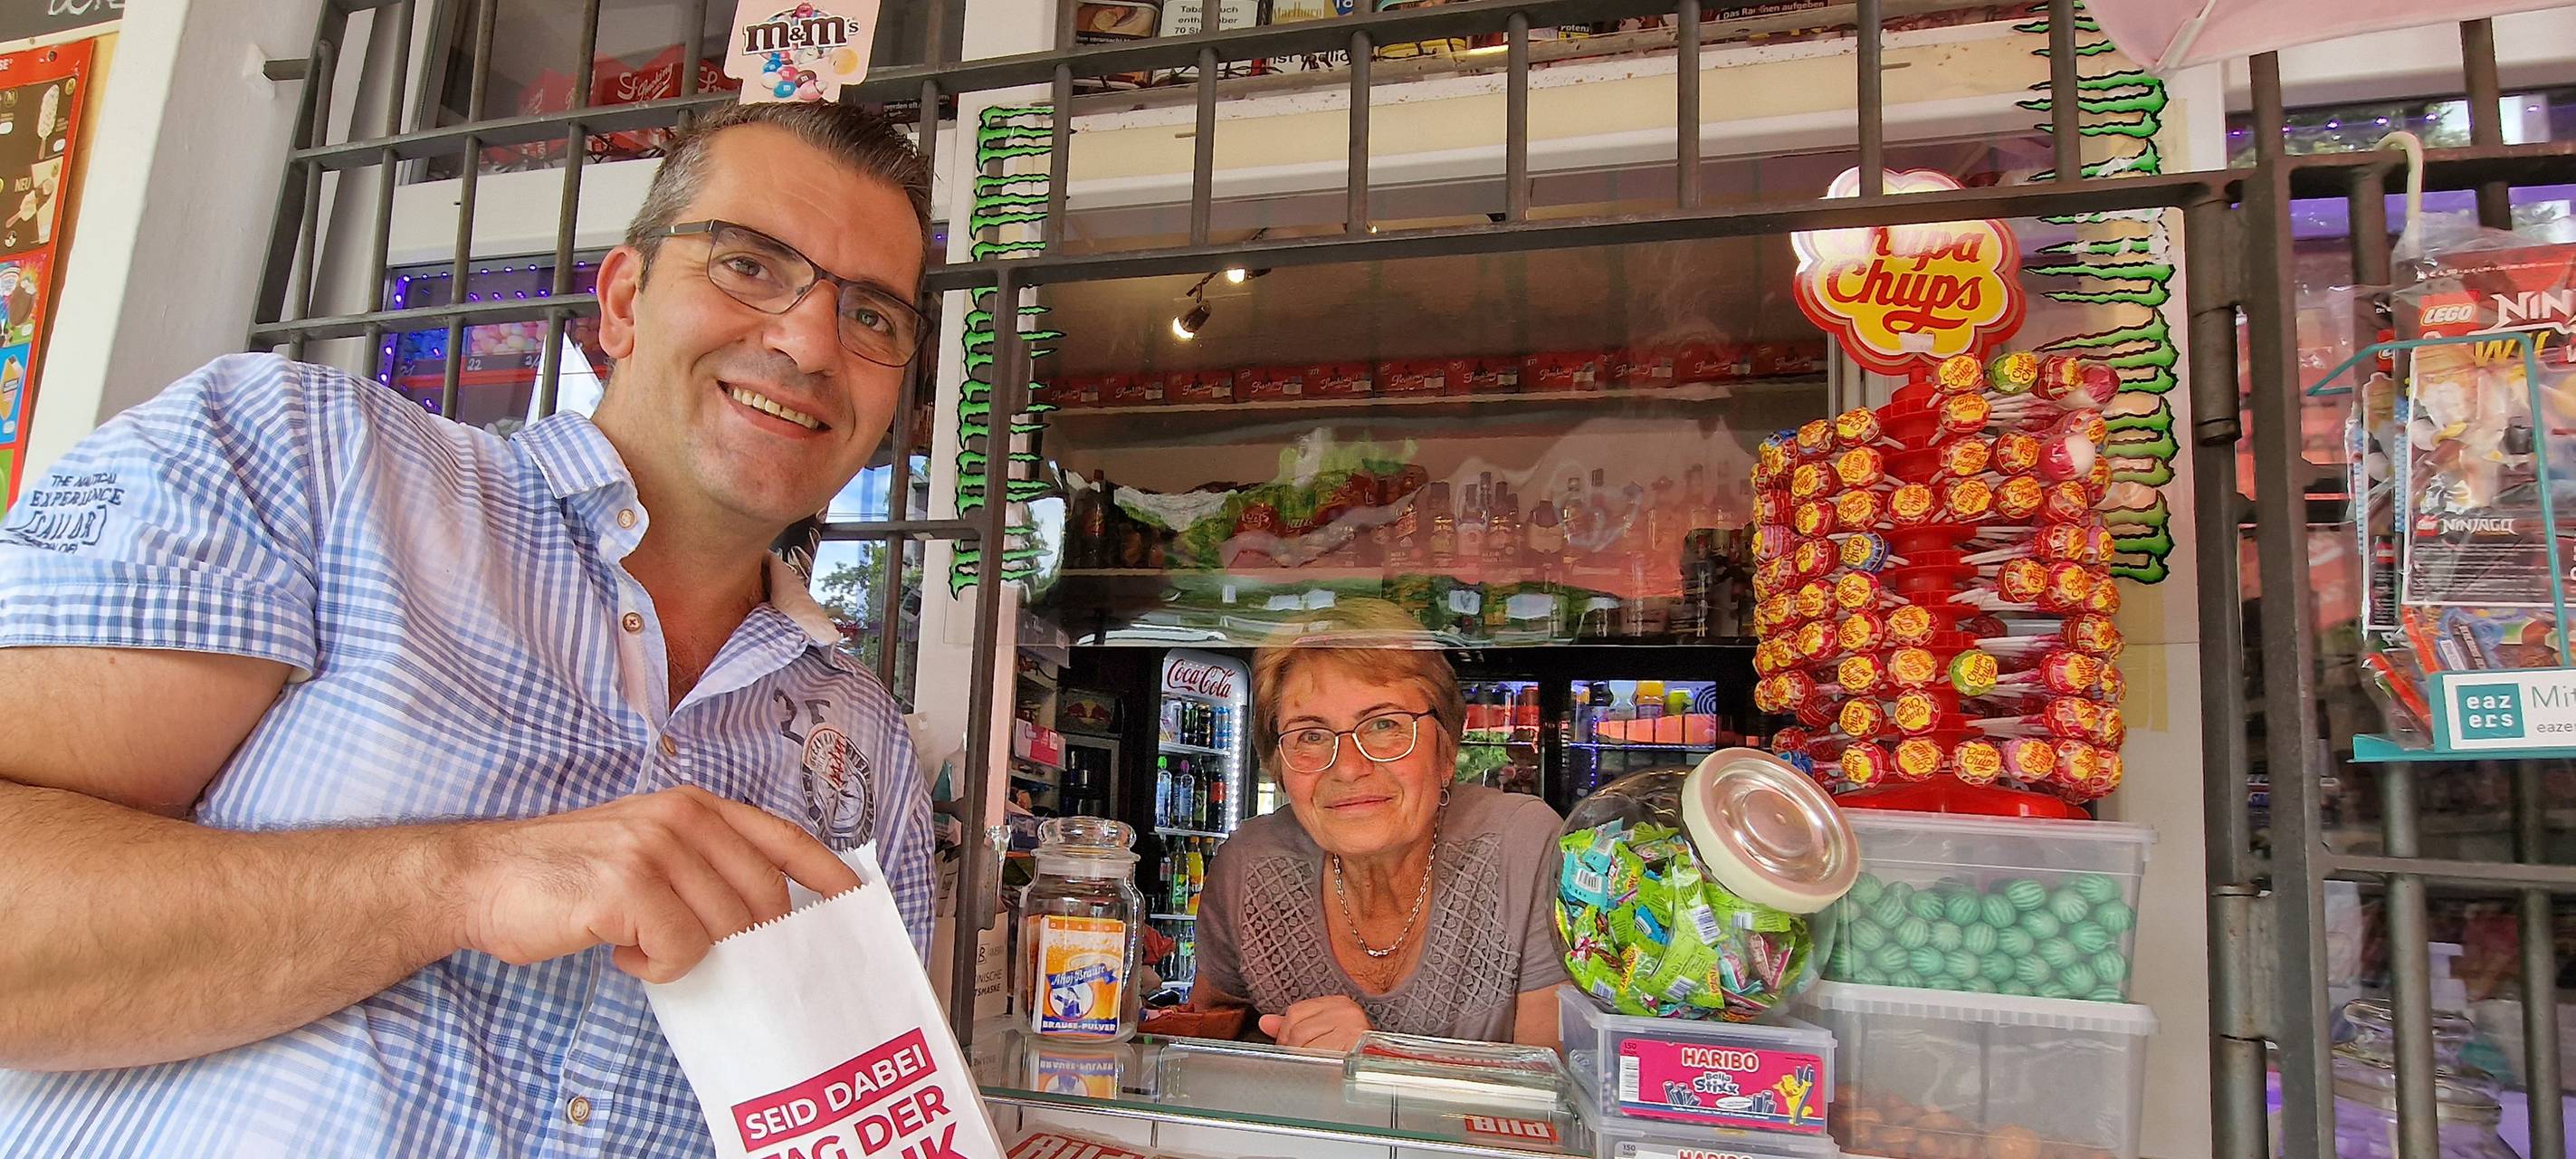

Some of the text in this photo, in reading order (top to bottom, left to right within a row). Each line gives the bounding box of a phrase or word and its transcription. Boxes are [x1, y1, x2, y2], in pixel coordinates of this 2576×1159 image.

[745, 15, 859, 52] m&m's
[14, 177, 31, 192] NEU
[1856, 225, 1986, 272] hupa
[1826, 259, 1984, 334] Chups
[2421, 303, 2476, 325] LEGO
[466, 358, 482, 370] 22
[52, 475, 73, 487] THE
[1167, 658, 1236, 699] Coca-Cola
[1966, 656, 1986, 682] Chupa
[2466, 694, 2513, 710] eaz
[2468, 713, 2514, 729] ers
[2536, 722, 2576, 733] eaze
[1968, 747, 1997, 758] Chupa
[1042, 1020, 1116, 1032] BRAUSE-PULVER
[1681, 1047, 1760, 1072] HARIBO
[745, 1098, 819, 1140] SEID
[824, 1043, 928, 1113] DABEI
[1693, 1078, 1740, 1096] Stixx
[854, 1085, 951, 1156] DER
[1474, 1116, 1551, 1139] Bild
